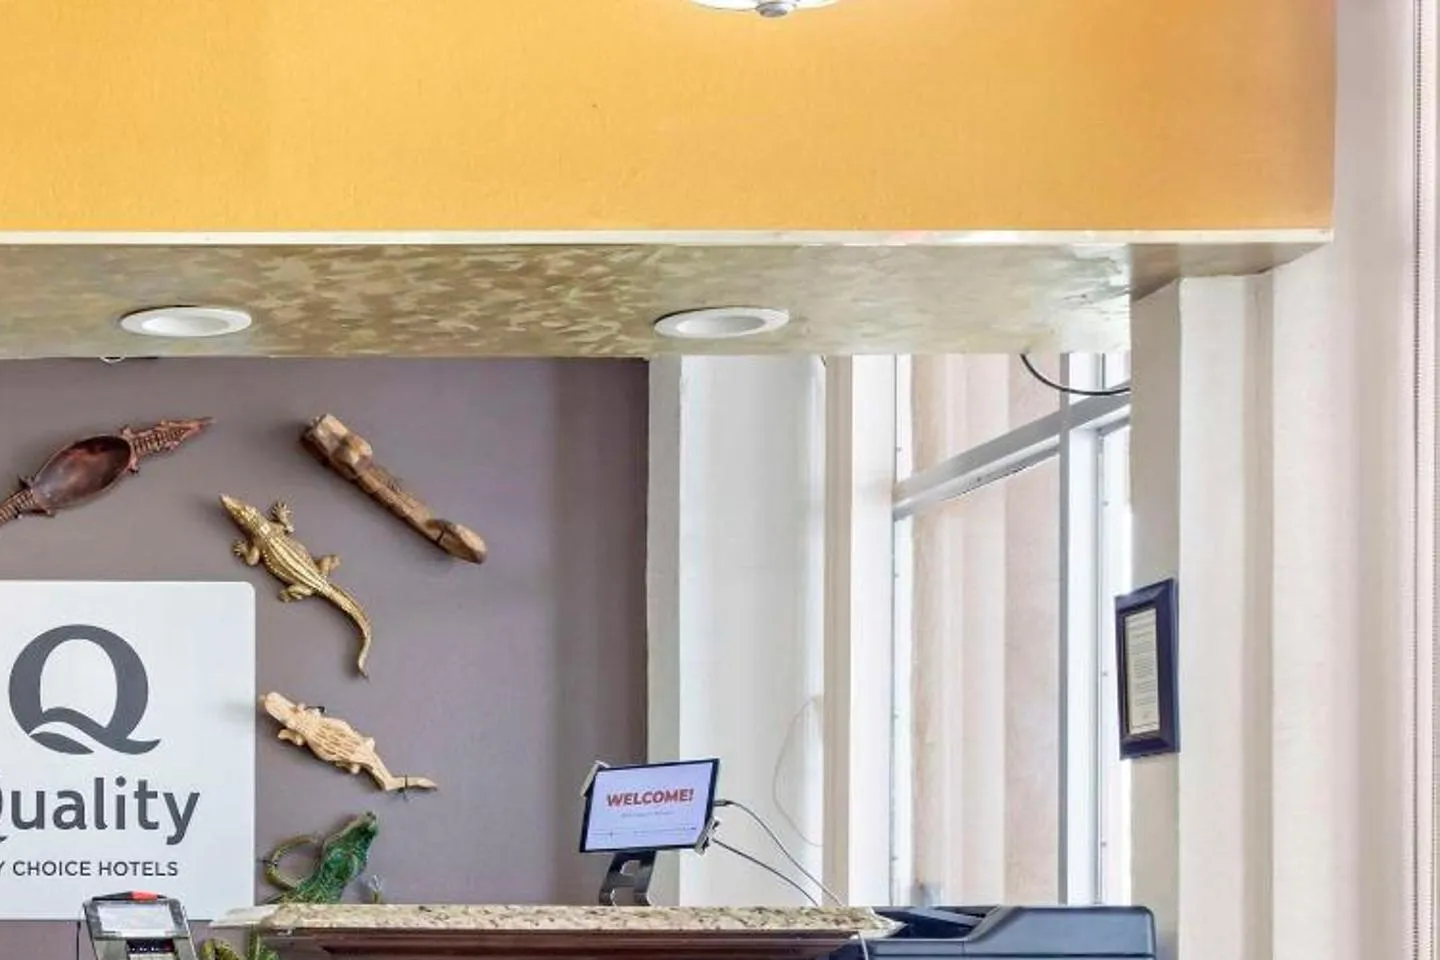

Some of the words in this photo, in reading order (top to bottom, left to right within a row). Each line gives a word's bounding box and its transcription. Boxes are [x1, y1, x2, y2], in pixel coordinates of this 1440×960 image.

[8, 624, 161, 755] Q
[607, 788, 694, 807] WELCOME!
[12, 860, 92, 877] CHOICE
[98, 860, 179, 877] HOTELS
